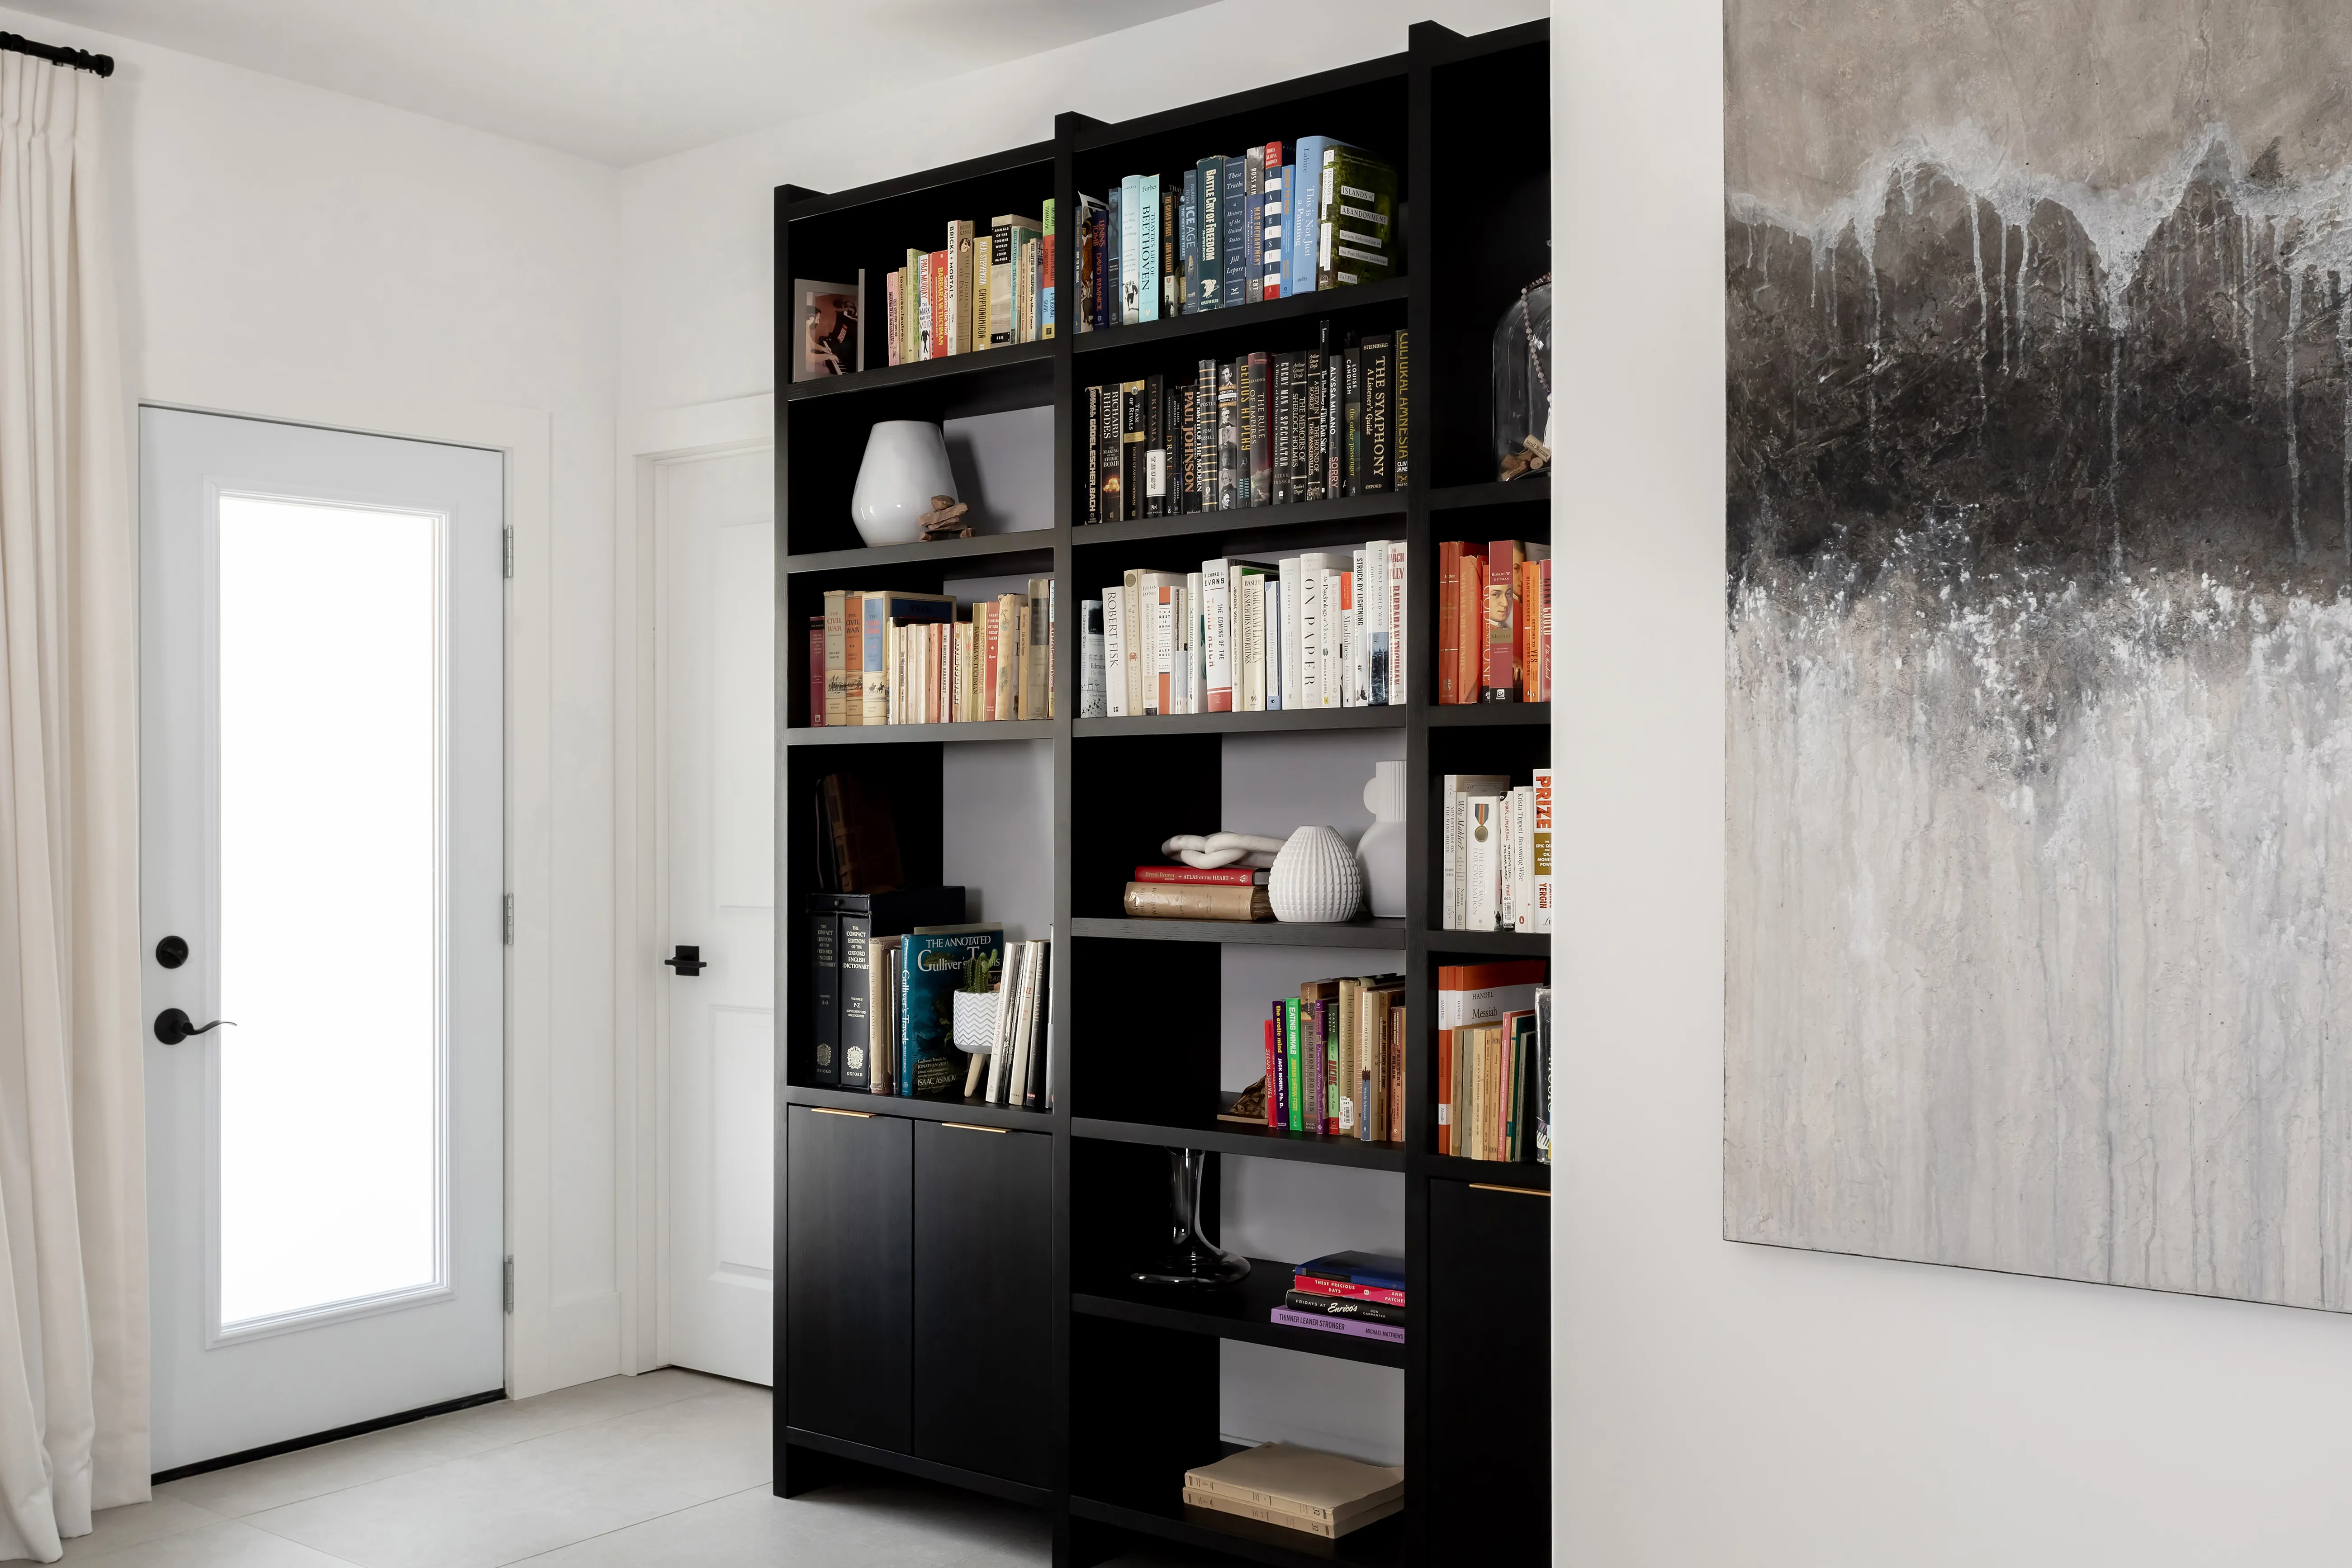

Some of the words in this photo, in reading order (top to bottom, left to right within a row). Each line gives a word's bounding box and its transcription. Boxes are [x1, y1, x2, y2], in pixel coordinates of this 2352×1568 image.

[1226, 182, 1243, 190] Truths
[1306, 185, 1315, 203] This
[1185, 205, 1195, 225] ICE
[1305, 208, 1314, 216] is
[1342, 207, 1387, 224] ABANDONMENT
[1305, 218, 1314, 235] Not
[1186, 226, 1195, 248] AGE
[1141, 205, 1150, 290] BEETHOVEN
[1230, 255, 1240, 264] Jill
[1226, 266, 1244, 275] Lepore
[920, 307, 930, 316] MARK
[977, 289, 986, 339] CRYPTONOMICON
[919, 320, 931, 329] VOID
[1280, 362, 1289, 386] EVERY
[1375, 356, 1385, 388] THE
[1250, 389, 1256, 402] OF
[1280, 390, 1289, 404] MAN
[1366, 377, 1374, 412] Listener's
[1185, 391, 1194, 424] PAUL
[1365, 413, 1373, 435] Guide
[1280, 416, 1288, 467] SPECULATOR
[1374, 392, 1385, 476] SYMPHONY
[1181, 425, 1194, 493] JOHNSON
[1298, 452, 1305, 463] OF
[1204, 578, 1225, 586] EVANS
[1304, 578, 1315, 605] ON
[1108, 592, 1118, 638] ROBERT
[1109, 643, 1119, 668] FISK
[1304, 616, 1315, 686] PAPER
[1536, 776, 1551, 829] PRIZE
[1539, 883, 1547, 909] YERGIN
[925, 938, 943, 948] THE
[944, 935, 991, 947] ANNOTATED
[1472, 991, 1494, 1000] HANDEL
[1472, 1007, 1498, 1019] Messiah
[1331, 1282, 1356, 1290] PRECIOUS
[1327, 1302, 1358, 1313] Enrico's
[1279, 1313, 1299, 1323] THINNER
[1299, 1316, 1318, 1326] LEANER
[1319, 1320, 1345, 1331] STRONGER
